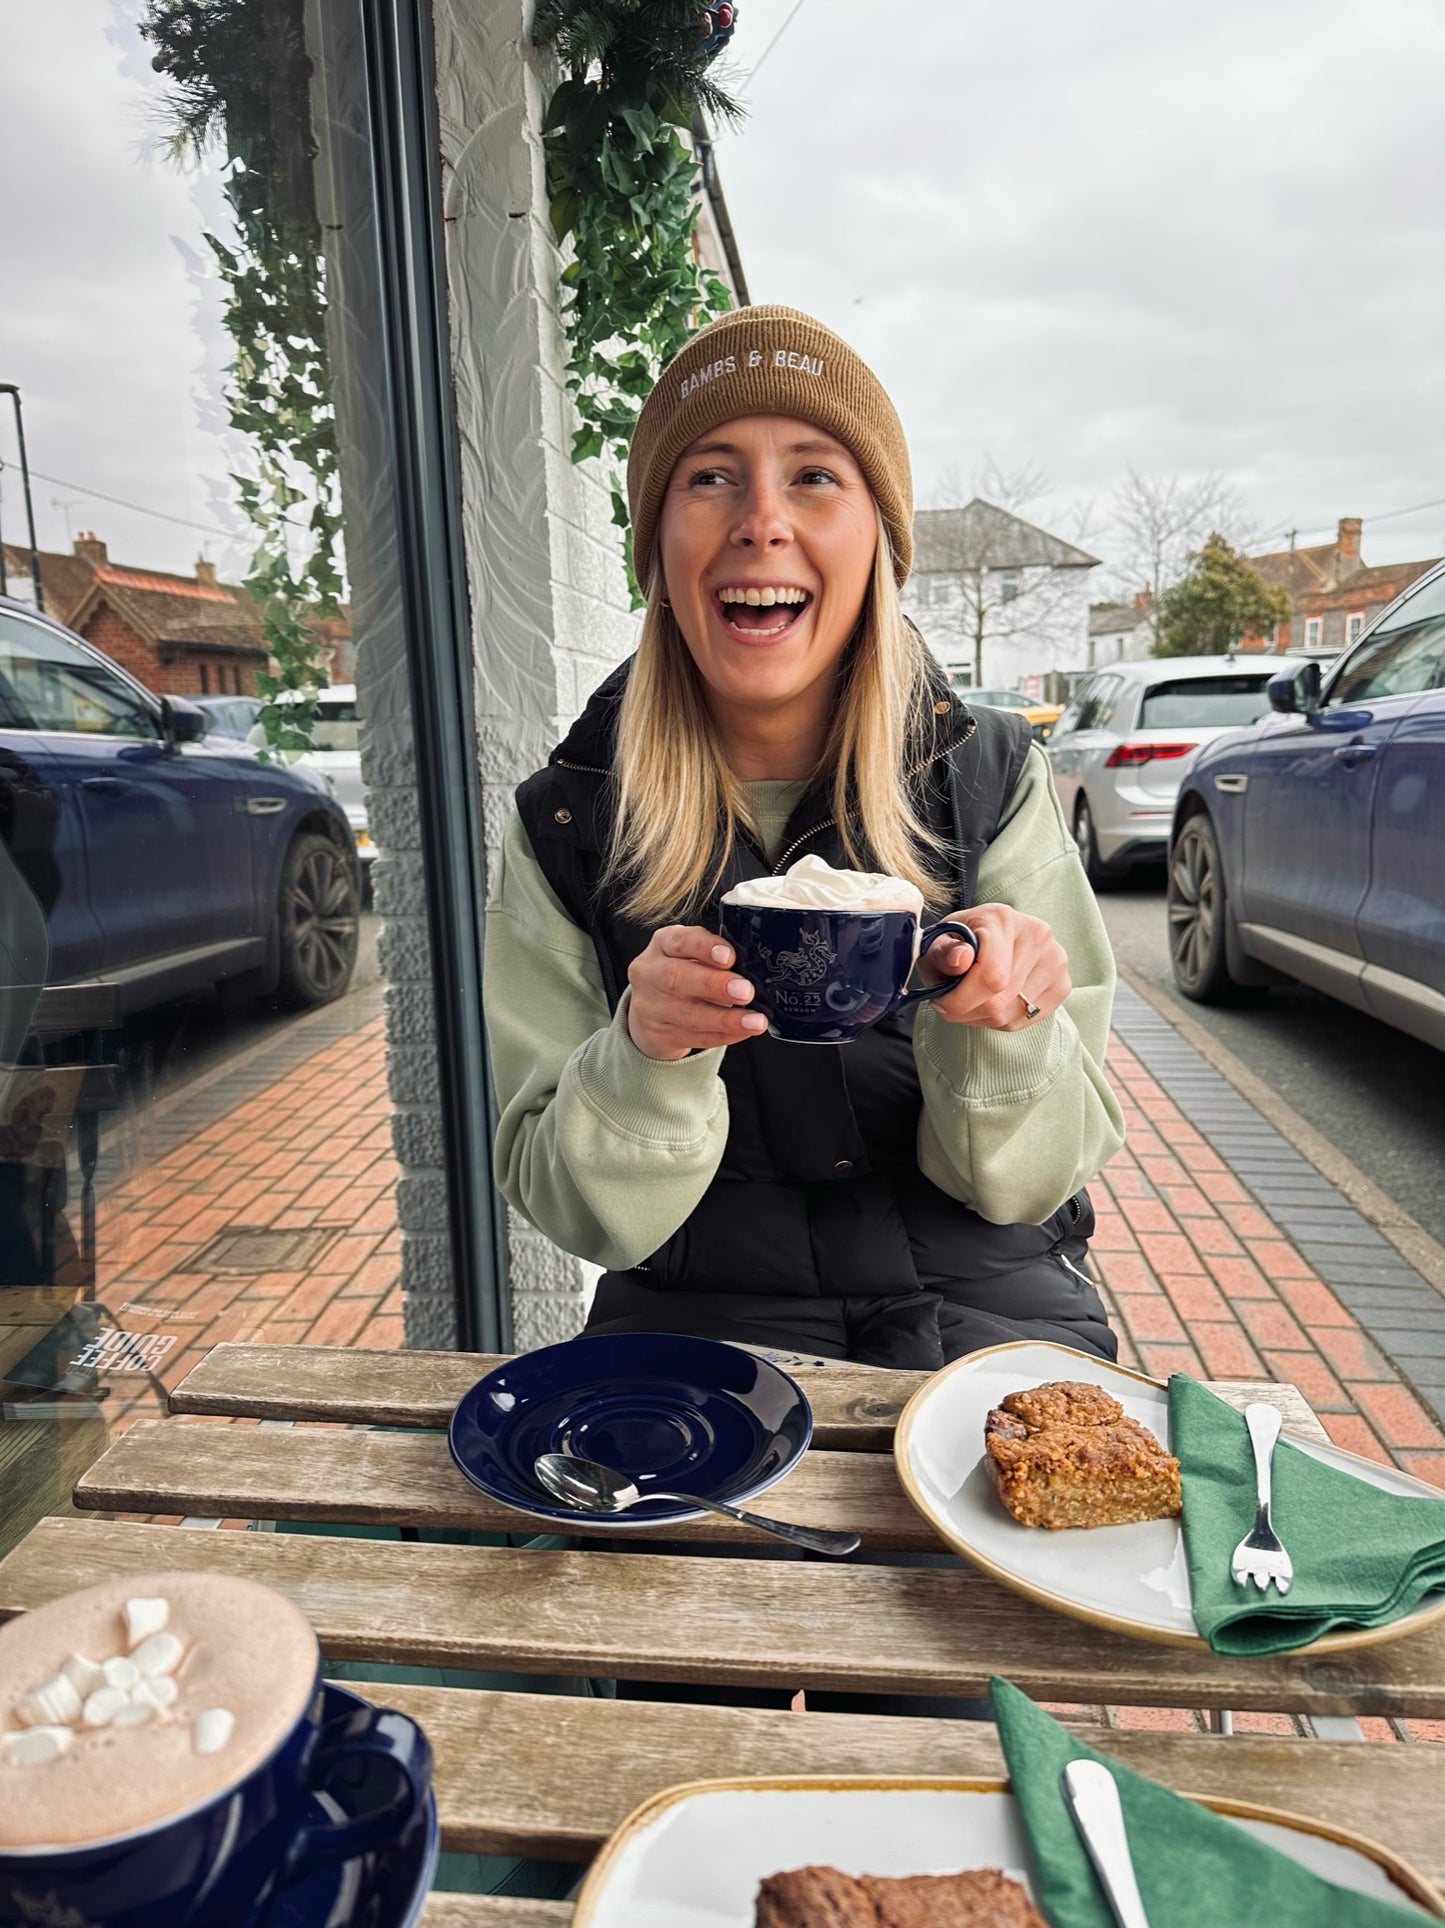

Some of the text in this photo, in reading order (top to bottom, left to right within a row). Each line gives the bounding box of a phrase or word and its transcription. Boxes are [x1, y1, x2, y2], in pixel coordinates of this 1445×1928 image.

[680, 350, 825, 399] BAMBS & BEAU
[85, 1327, 178, 1354] GUIDE
[69, 1347, 163, 1371] COFFEE
